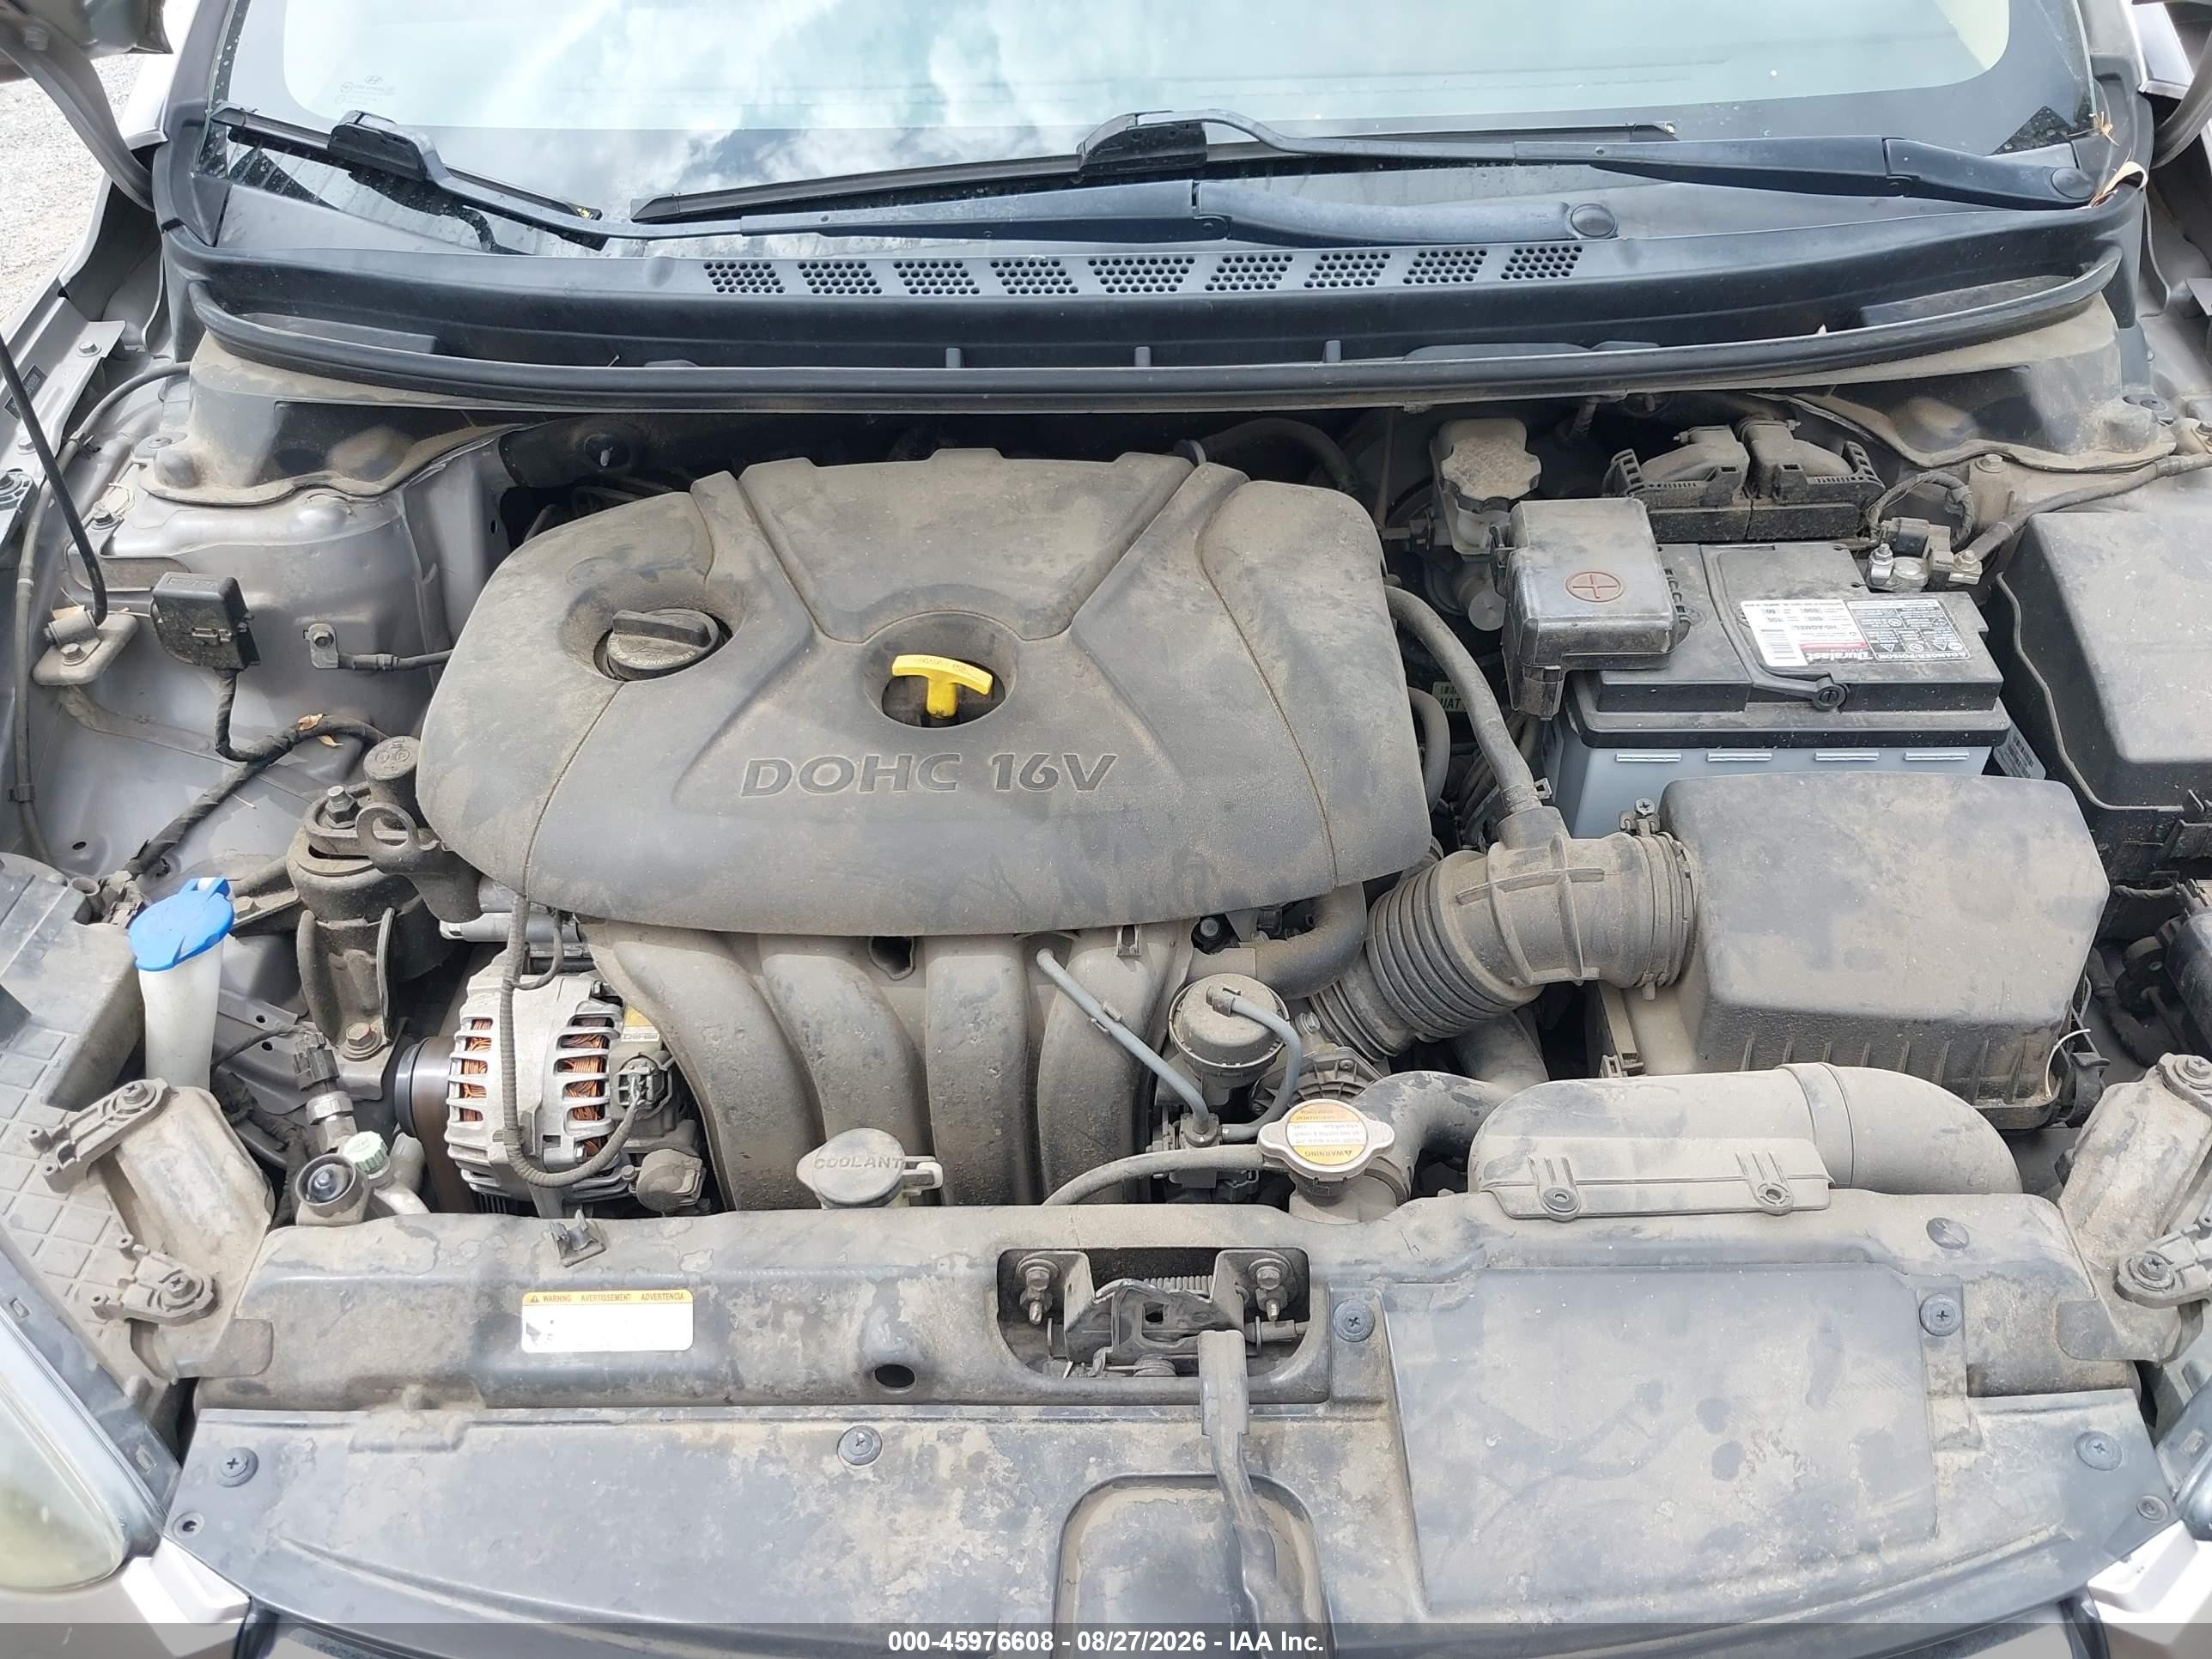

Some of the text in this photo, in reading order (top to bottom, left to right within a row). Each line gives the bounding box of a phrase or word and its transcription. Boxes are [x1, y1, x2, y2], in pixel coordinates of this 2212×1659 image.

[1806, 651, 1873, 661] Duralast
[740, 752, 1118, 797] DOHC 16V
[813, 1156, 903, 1170] COOLANT
[543, 1292, 684, 1303] WARNING AVERTISSEMENT ADVERTENCIA
